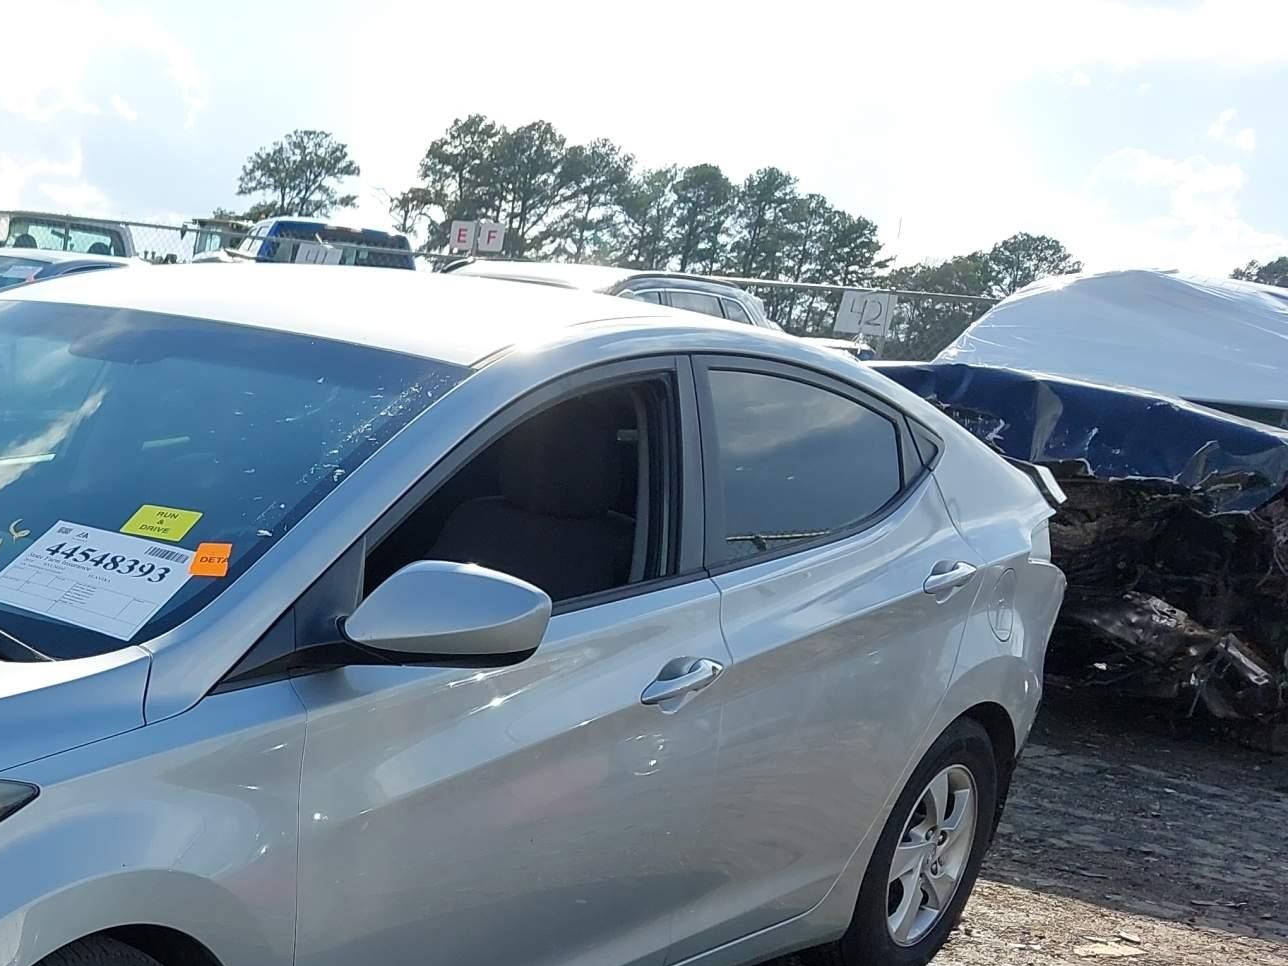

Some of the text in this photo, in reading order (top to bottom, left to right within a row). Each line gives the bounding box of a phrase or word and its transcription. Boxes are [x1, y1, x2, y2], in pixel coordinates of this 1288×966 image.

[457, 228, 468, 243] E
[487, 230, 498, 245] F
[850, 299, 881, 326] 42
[156, 511, 179, 519] RUN
[139, 524, 171, 534] DRIVE
[46, 542, 171, 583] 44548393
